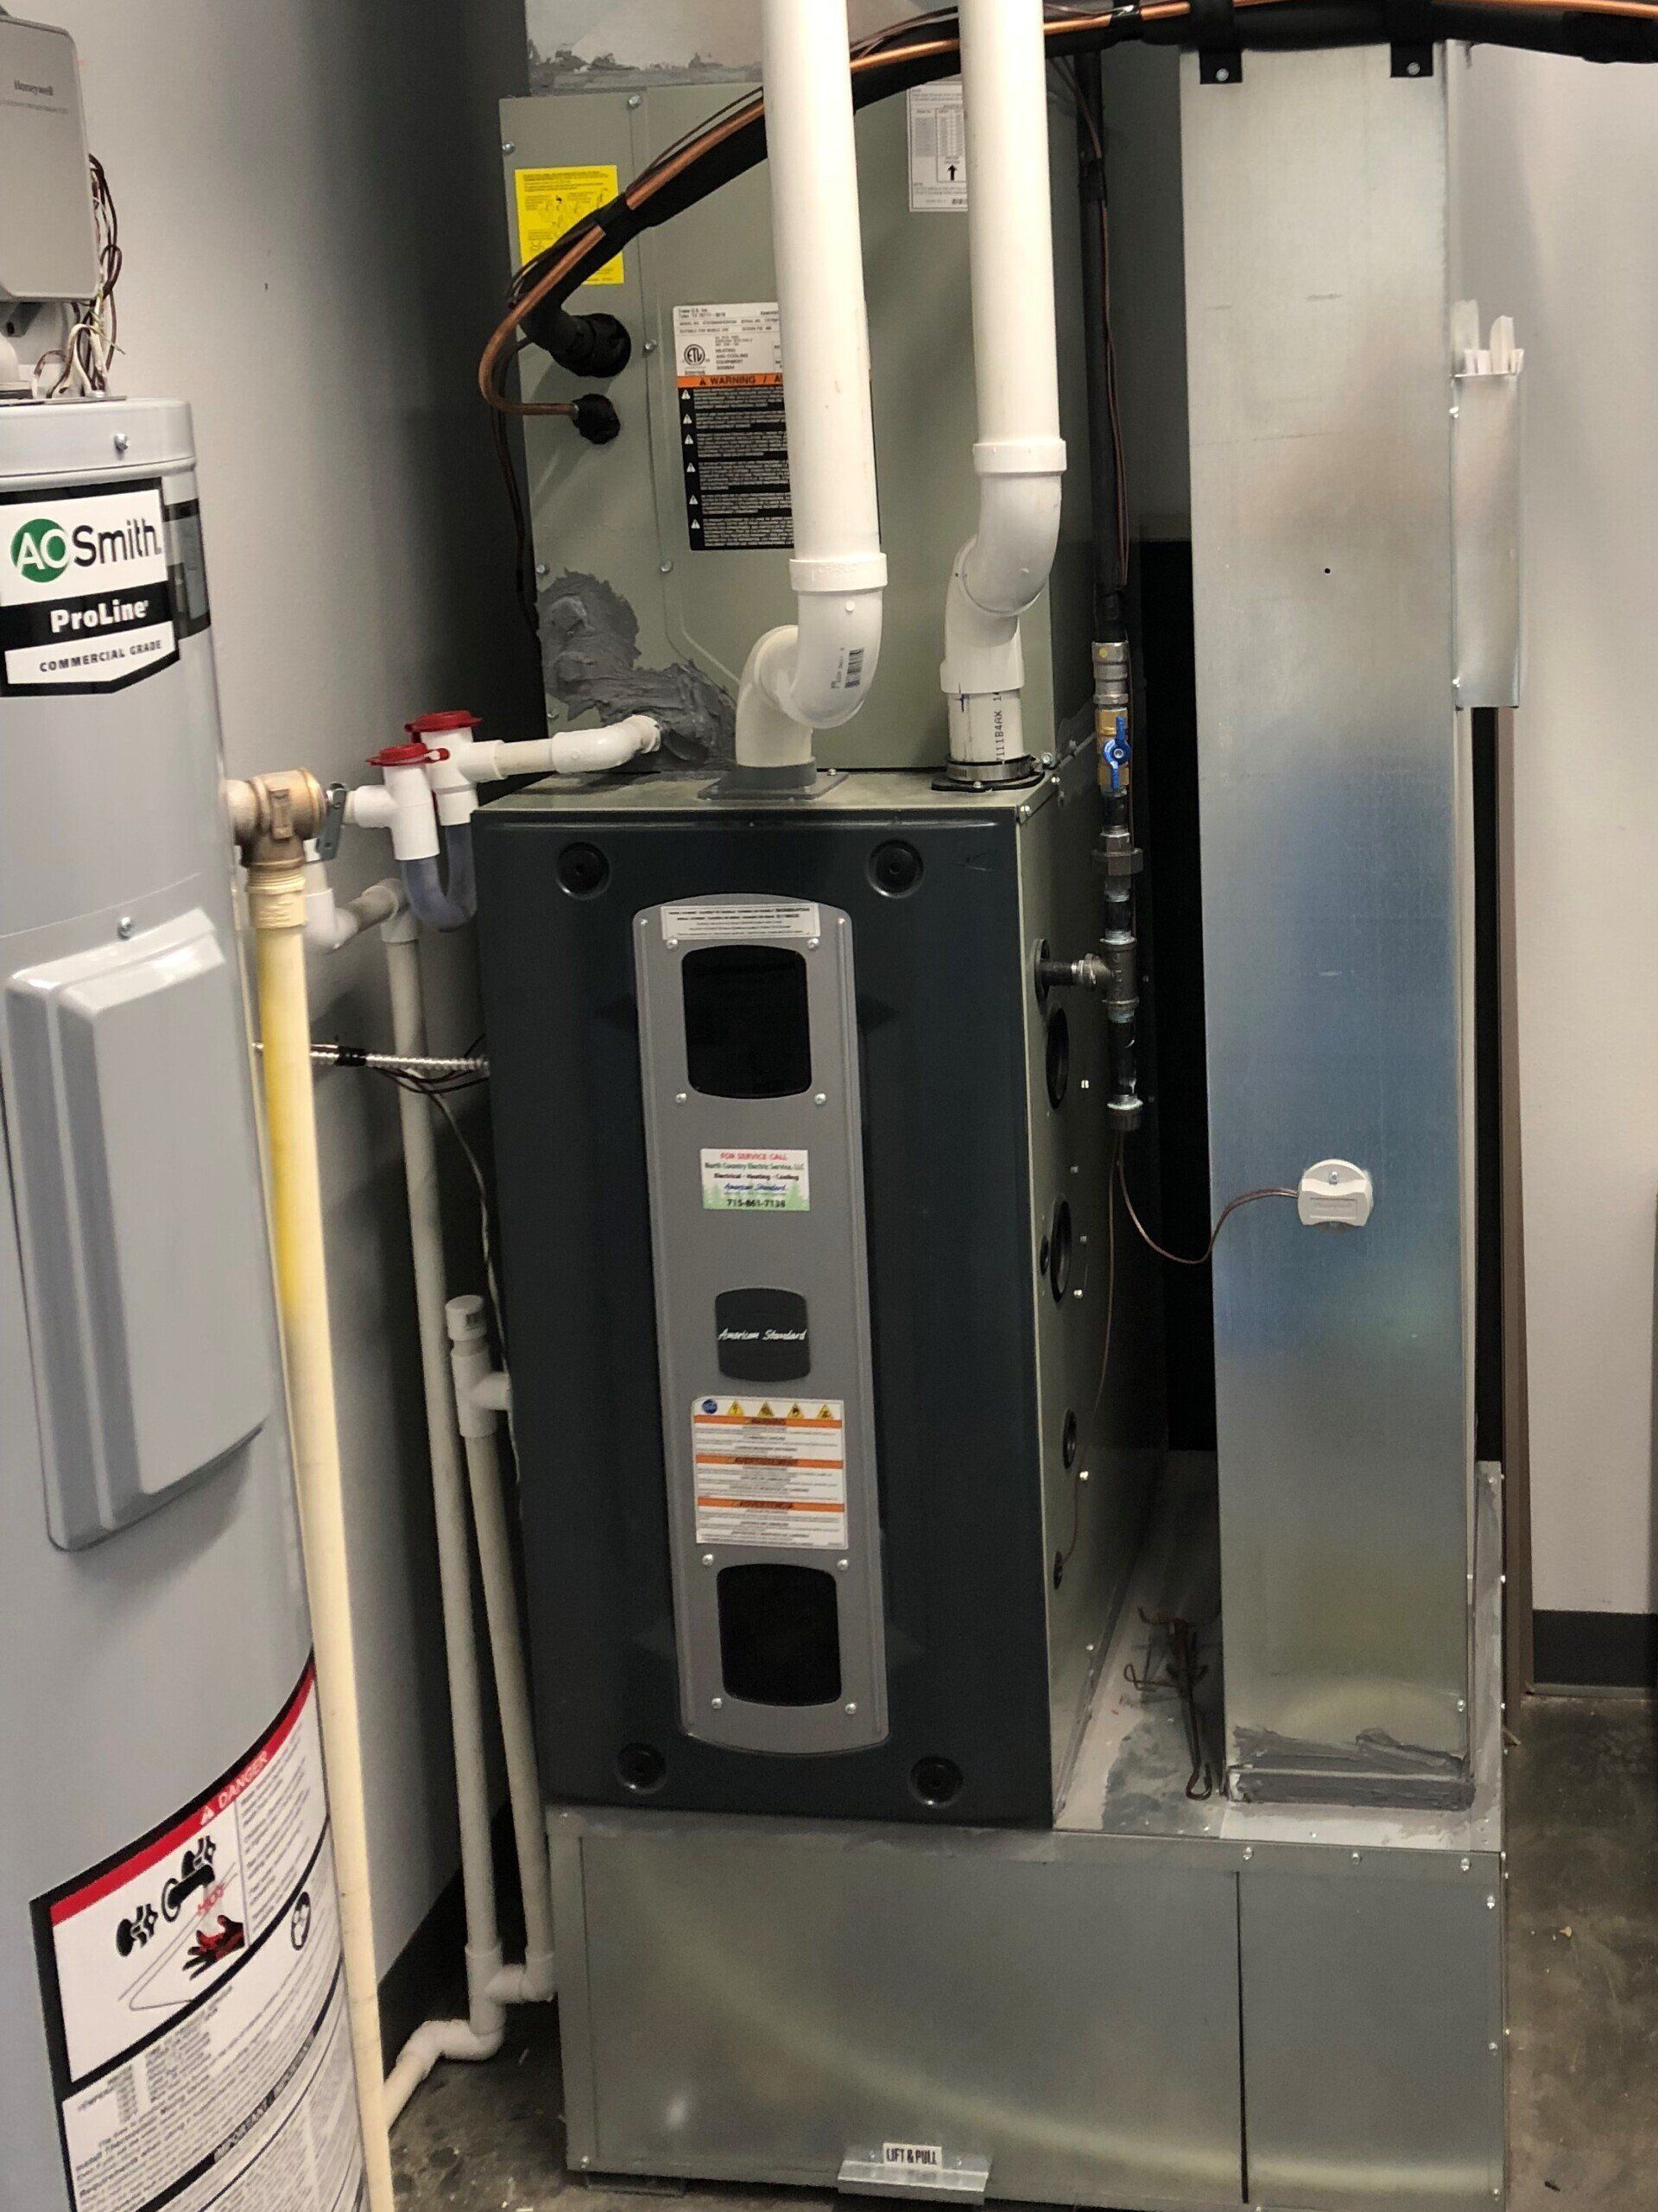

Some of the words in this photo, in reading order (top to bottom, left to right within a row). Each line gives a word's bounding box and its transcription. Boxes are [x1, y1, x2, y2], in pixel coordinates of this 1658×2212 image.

[710, 375, 756, 384] WARNING
[49, 598, 148, 634] ProLine
[39, 649, 125, 673] COMMERCIAL
[129, 639, 161, 656] GRADE
[720, 1151, 735, 1160] FOR
[737, 1152, 767, 1161] SERVICE
[717, 1328, 760, 1341] American
[762, 1328, 807, 1341] Standard
[218, 1750, 269, 1810] DANGER
[886, 2147, 905, 2163] LIFT
[907, 2148, 914, 2164] &
[915, 2149, 938, 2165] PULL
